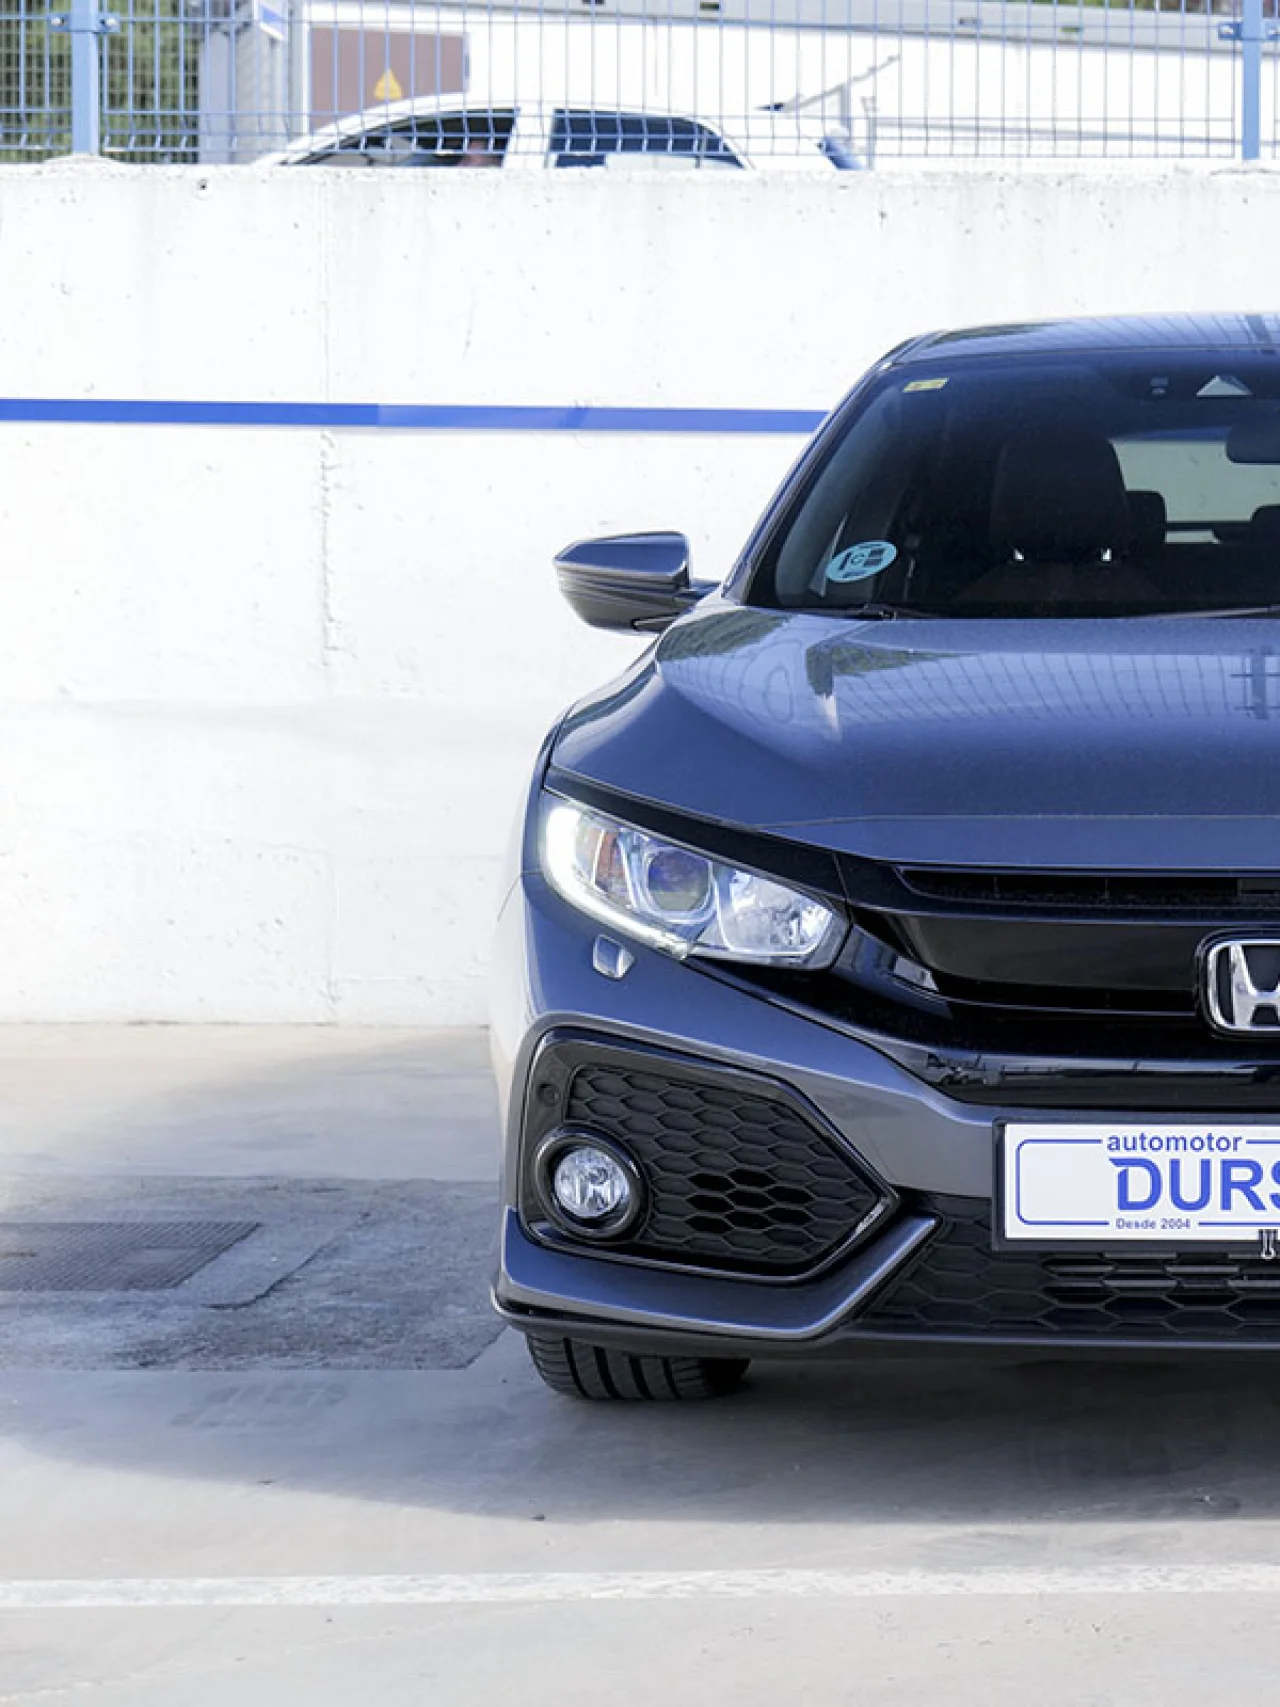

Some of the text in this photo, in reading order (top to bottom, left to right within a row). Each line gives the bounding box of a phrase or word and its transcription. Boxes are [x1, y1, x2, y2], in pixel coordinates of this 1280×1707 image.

[1106, 1131, 1242, 1152] automotor
[1115, 1217, 1192, 1230] Desde 2004
